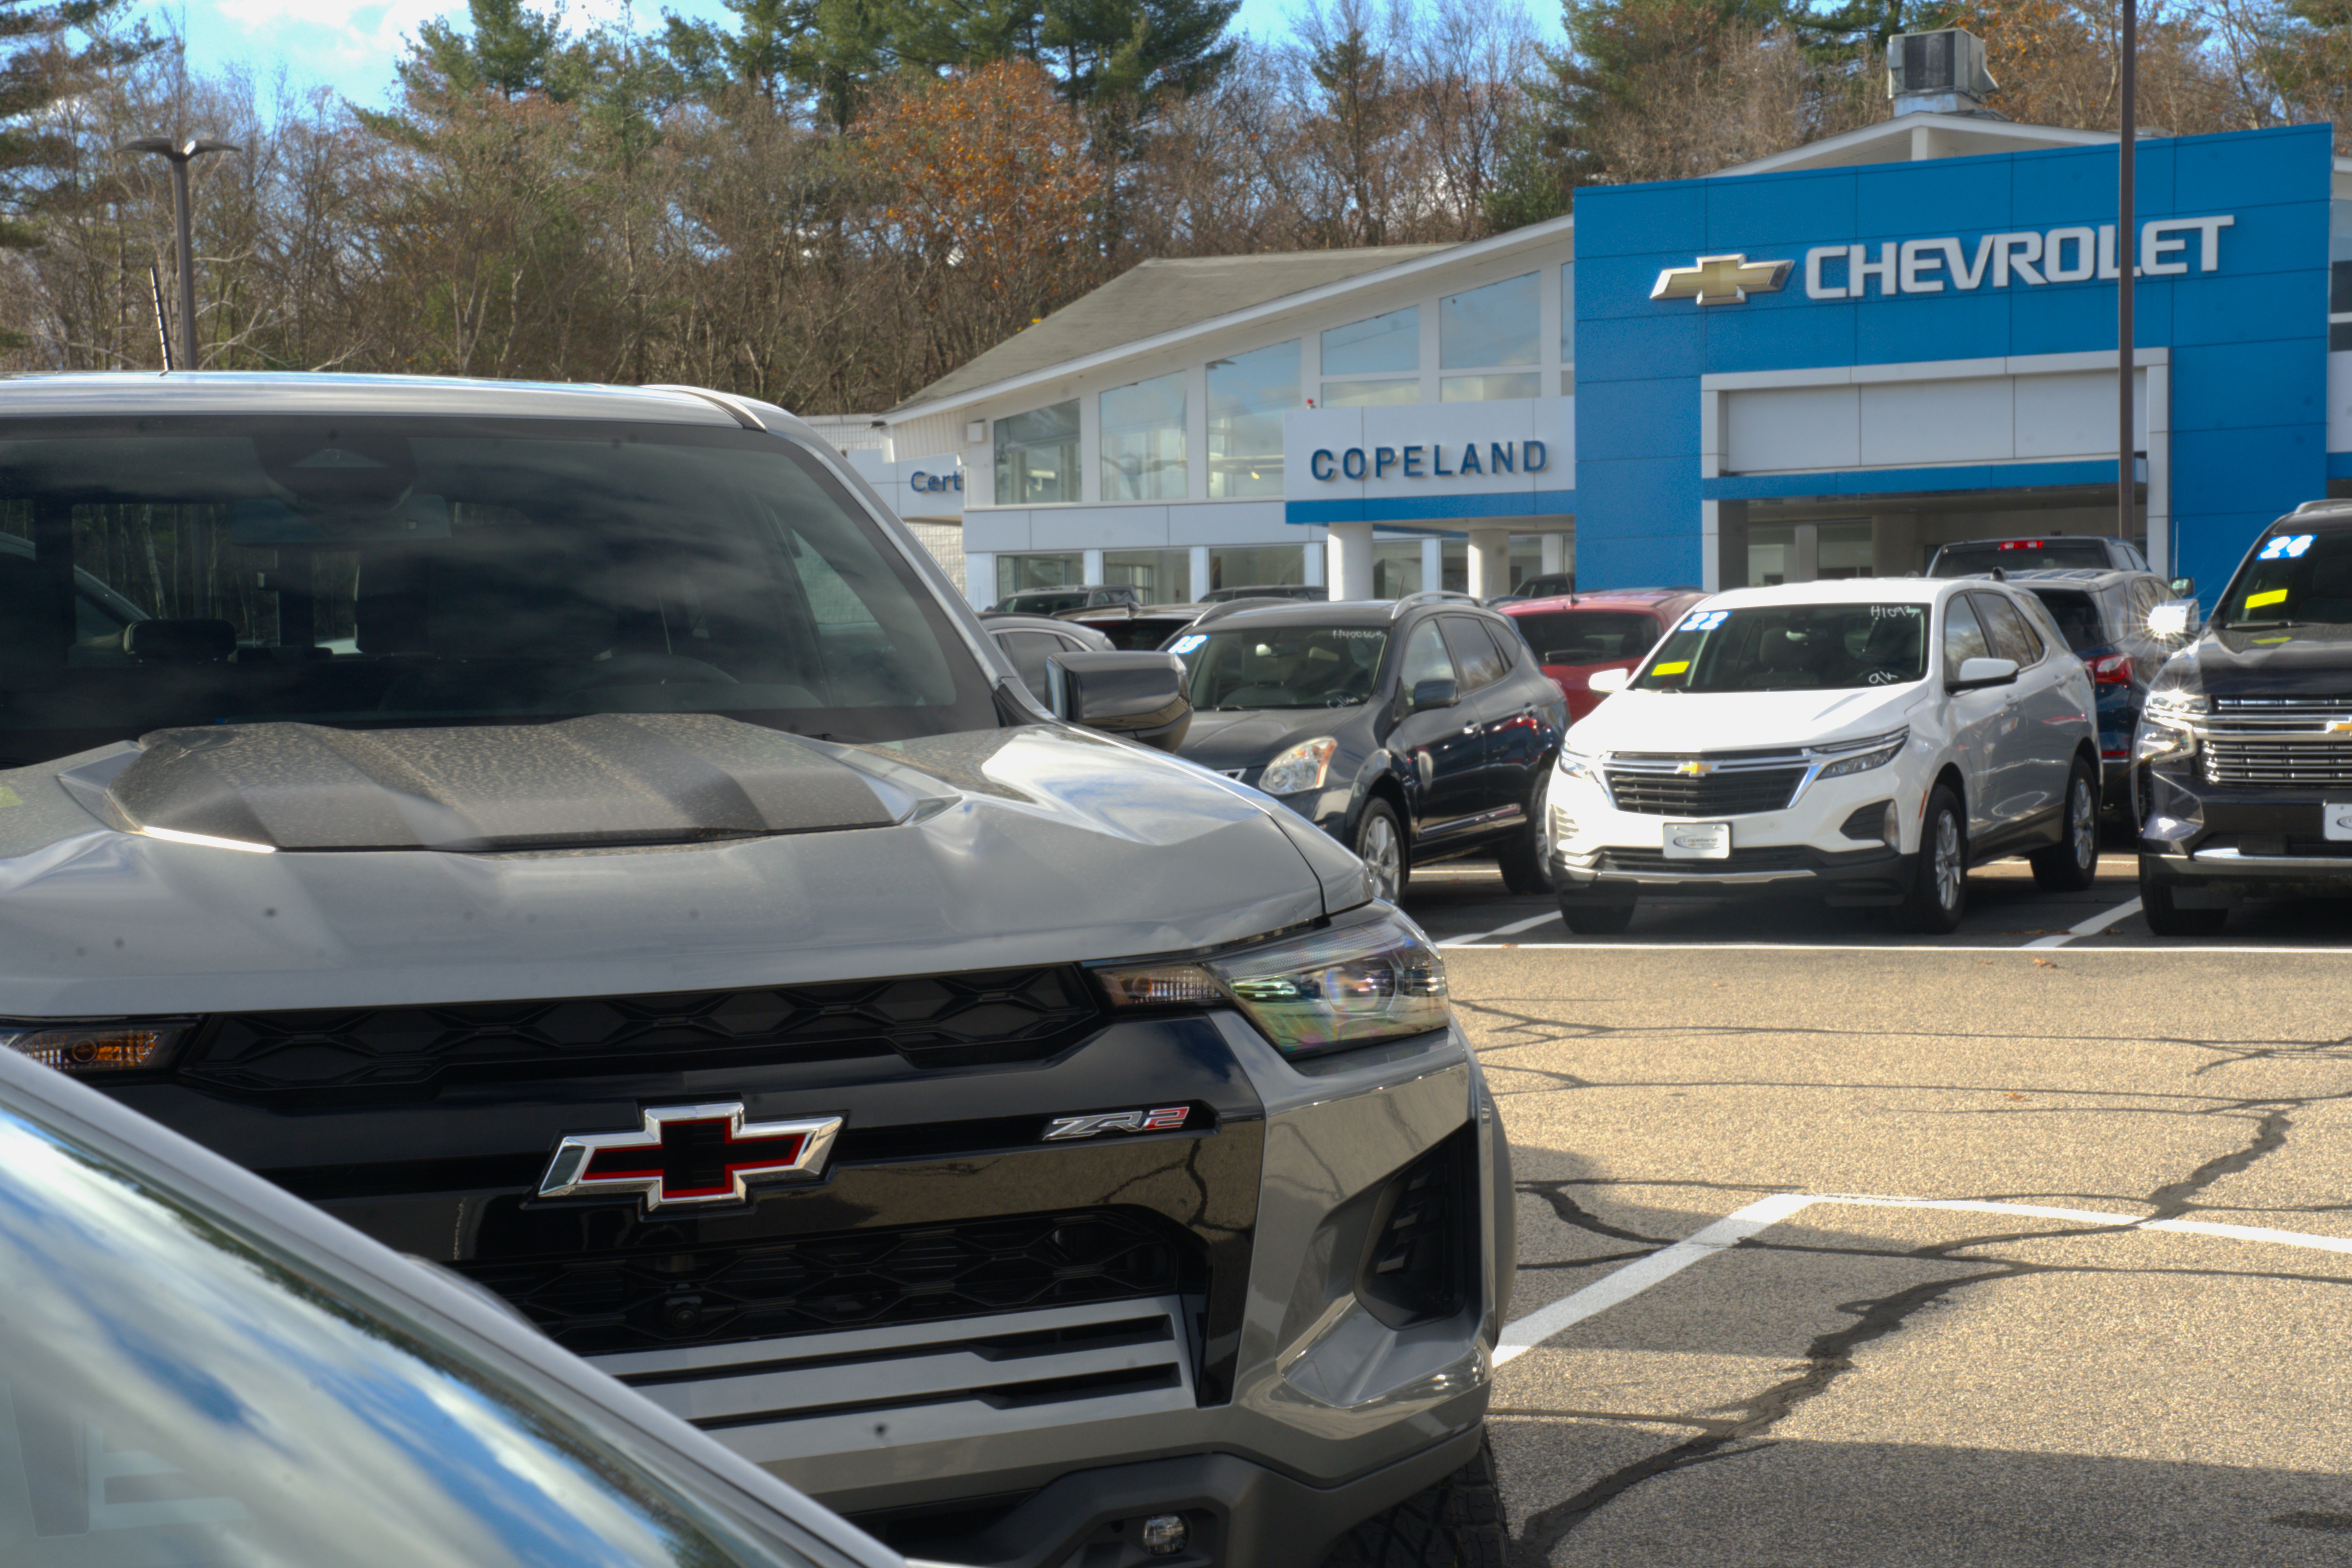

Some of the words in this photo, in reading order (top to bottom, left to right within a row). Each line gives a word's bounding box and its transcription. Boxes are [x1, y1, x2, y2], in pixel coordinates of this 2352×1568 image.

[1806, 215, 2234, 299] CHEVROLET
[1311, 440, 1546, 481] COPELAND
[911, 471, 964, 492] Cert
[1042, 1106, 1190, 1141] ZR2
